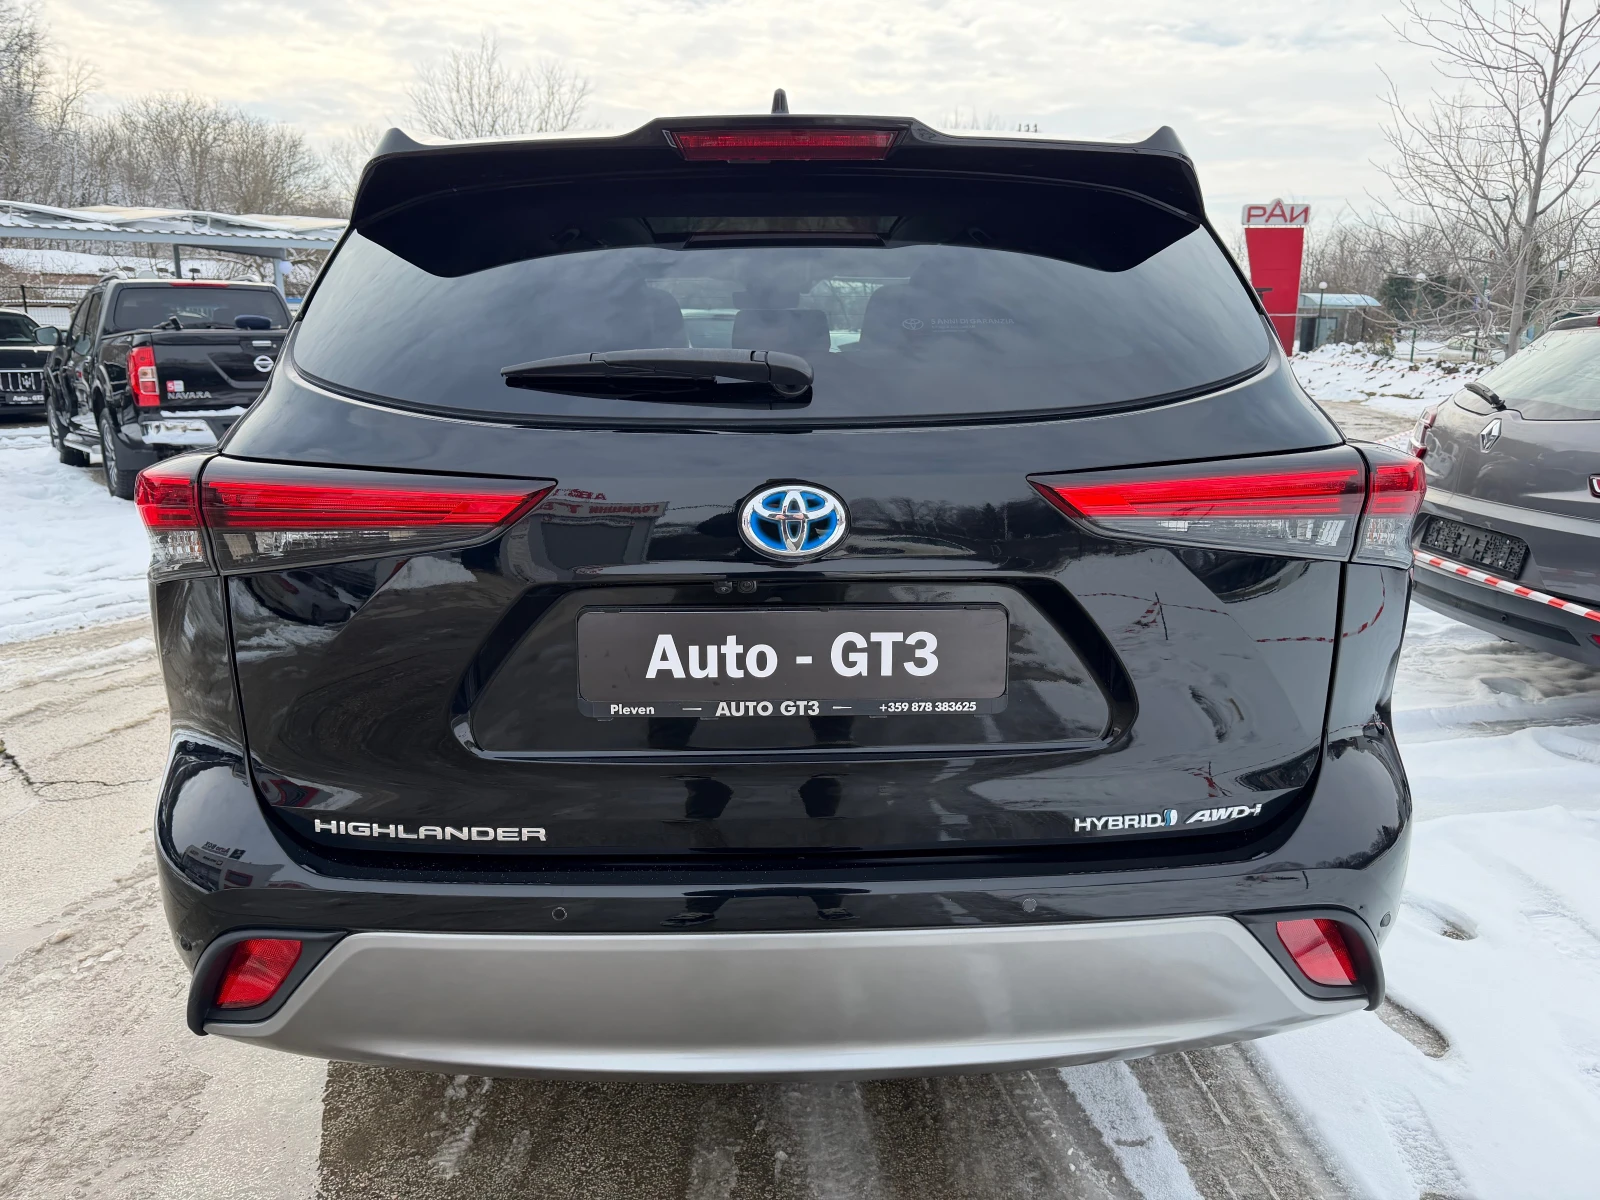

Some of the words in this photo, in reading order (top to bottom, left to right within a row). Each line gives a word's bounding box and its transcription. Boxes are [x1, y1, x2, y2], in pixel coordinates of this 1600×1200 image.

[167, 391, 212, 400] NAVARA
[645, 633, 778, 679] Auto
[796, 655, 813, 664] -
[830, 630, 939, 677] GT3
[610, 704, 655, 715] Pleven
[715, 701, 774, 717] AUTO
[780, 700, 820, 716] GT3
[879, 702, 909, 712] +359
[911, 702, 933, 711] 878
[935, 701, 977, 711] 383625
[314, 819, 547, 842] HIGHLANDER
[1074, 813, 1164, 832] HYBRID
